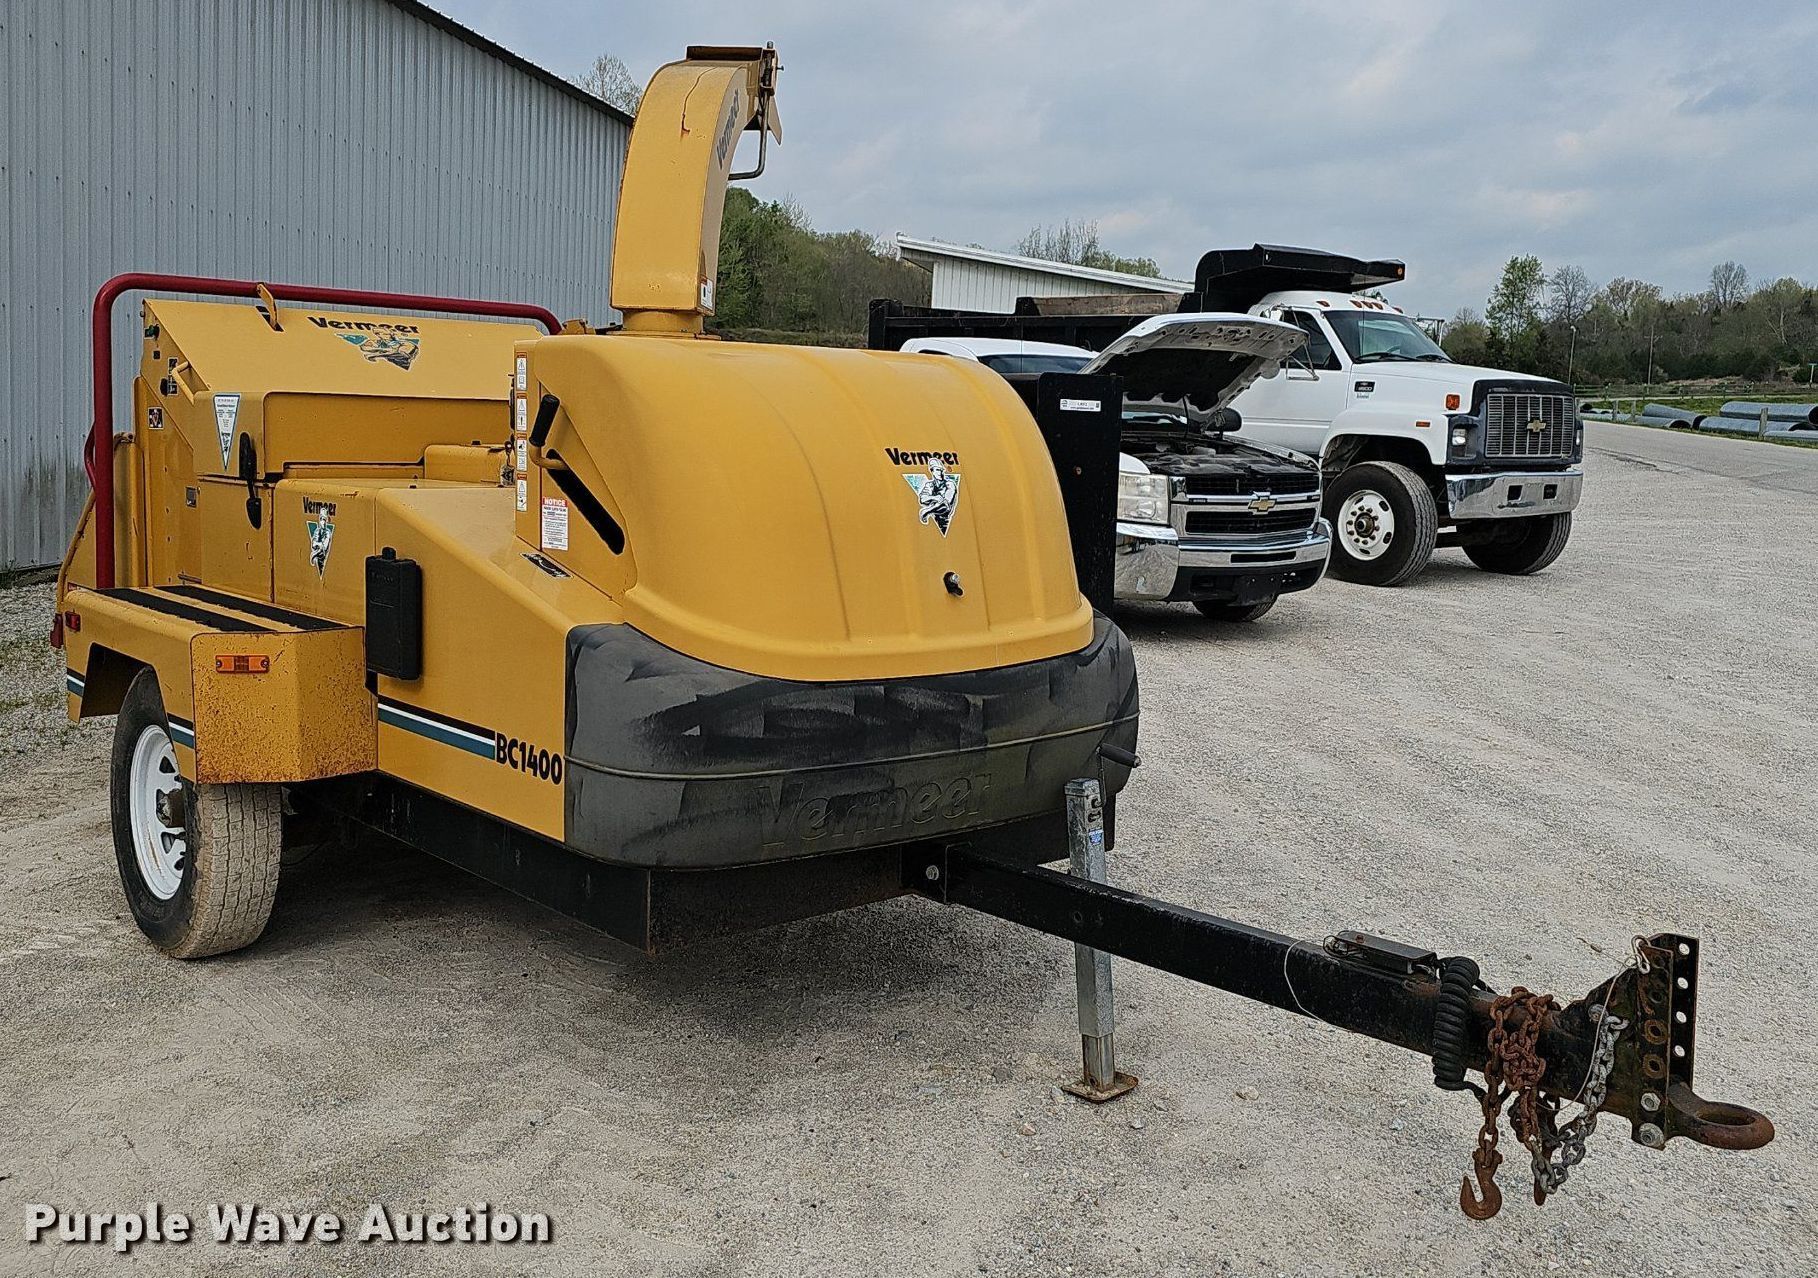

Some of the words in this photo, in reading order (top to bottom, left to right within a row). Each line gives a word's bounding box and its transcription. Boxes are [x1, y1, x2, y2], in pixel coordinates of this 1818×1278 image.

[306, 316, 420, 334] Vermeer
[884, 447, 960, 466] Vermeer
[302, 495, 337, 517] Vermeer
[543, 498, 567, 507] NOTICE
[496, 732, 563, 785] BC1400
[754, 772, 992, 847] Vermeer
